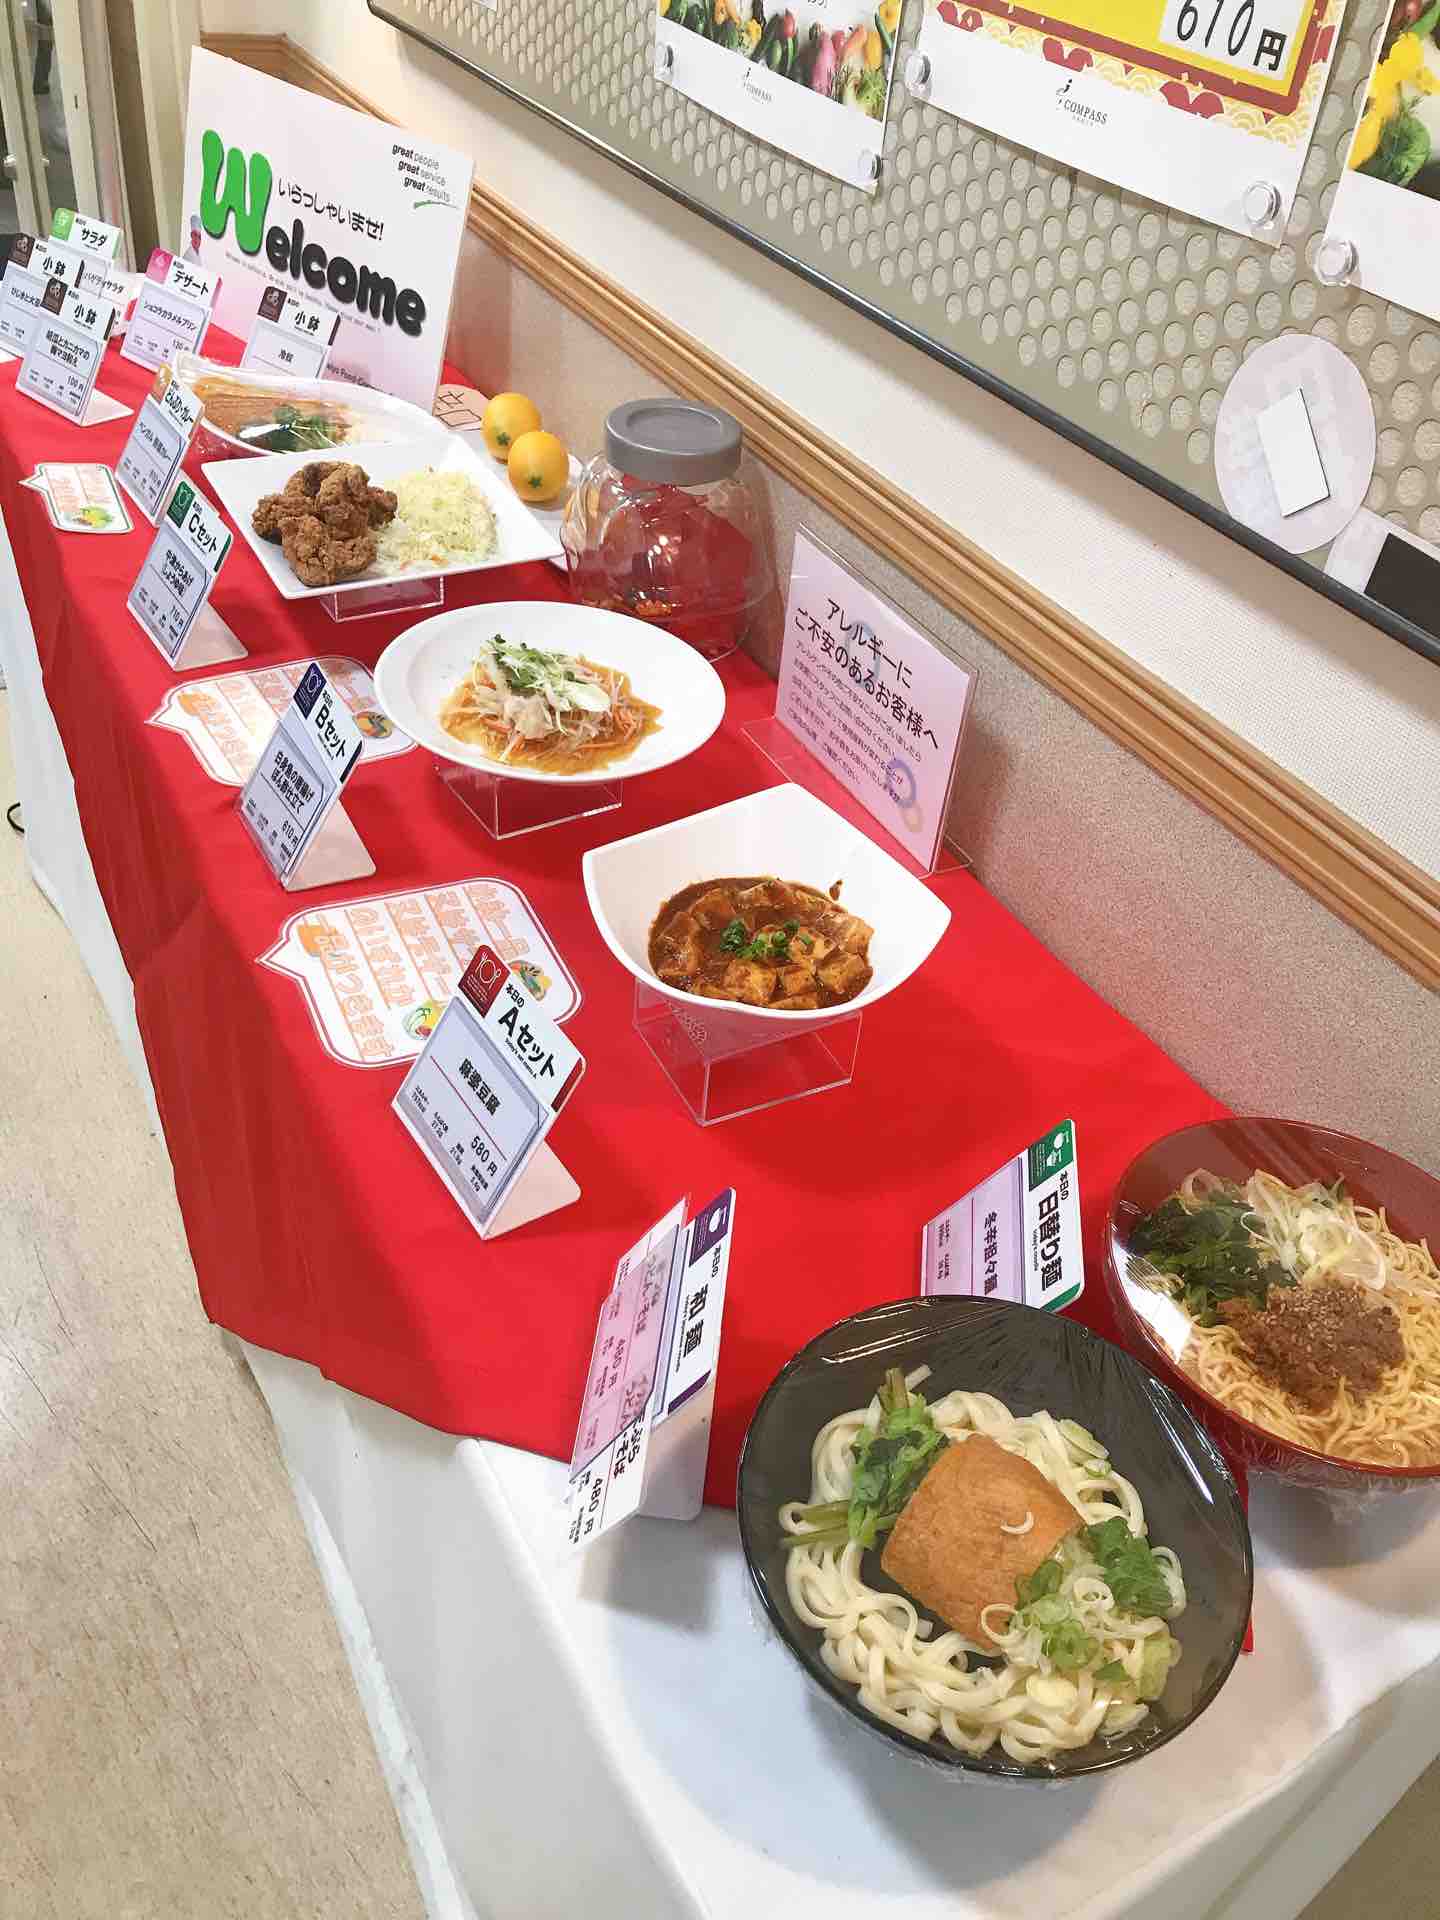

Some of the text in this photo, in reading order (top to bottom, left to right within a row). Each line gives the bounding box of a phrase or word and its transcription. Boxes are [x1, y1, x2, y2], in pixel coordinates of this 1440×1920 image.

[1064, 99, 1108, 125] COMPASS
[392, 144, 440, 170] great people
[398, 160, 420, 175] great
[404, 176, 426, 192] great
[81, 227, 108, 247] サラダ
[200, 129, 427, 338] Welcome
[42, 256, 67, 277] 小鉢
[173, 270, 209, 295] デザート
[74, 303, 97, 326] 小鉢
[294, 310, 321, 333] 小鉢
[188, 514, 217, 554] Cセット
[825, 597, 914, 690] アレルギーに
[793, 606, 940, 750] ご不安のあるお客様へ
[315, 704, 347, 759] Bセット
[498, 1006, 556, 1079] Aセット
[458, 1057, 501, 1117] 麻婆豆腐
[471, 1135, 498, 1177] 580 円
[1038, 1190, 1063, 1292] 日替り麺
[588, 1478, 602, 1513] 480
